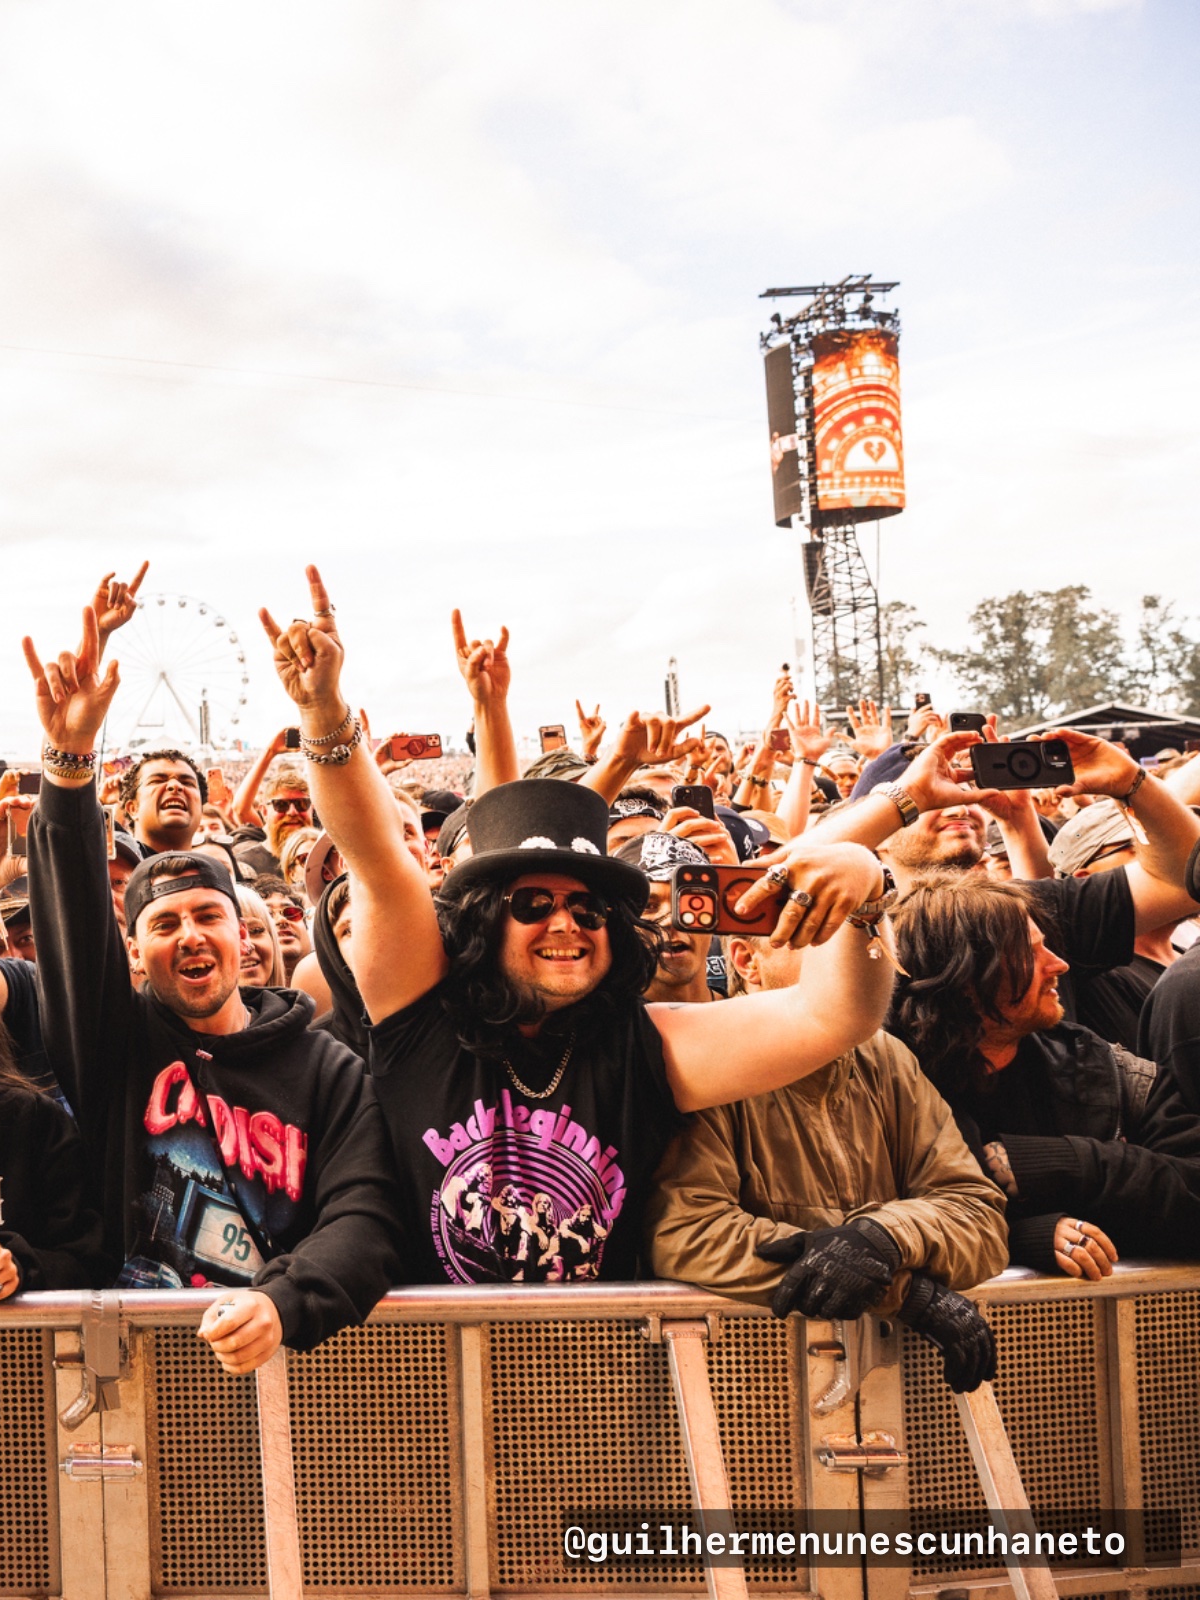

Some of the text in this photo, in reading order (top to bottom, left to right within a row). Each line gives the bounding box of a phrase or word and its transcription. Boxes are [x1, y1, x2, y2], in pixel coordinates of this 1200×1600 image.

[421, 1098, 496, 1168] Back
[431, 1188, 441, 1207] THE
[429, 1206, 440, 1234] FINAL
[219, 1222, 252, 1262] 95
[432, 1233, 447, 1259] SHOW
